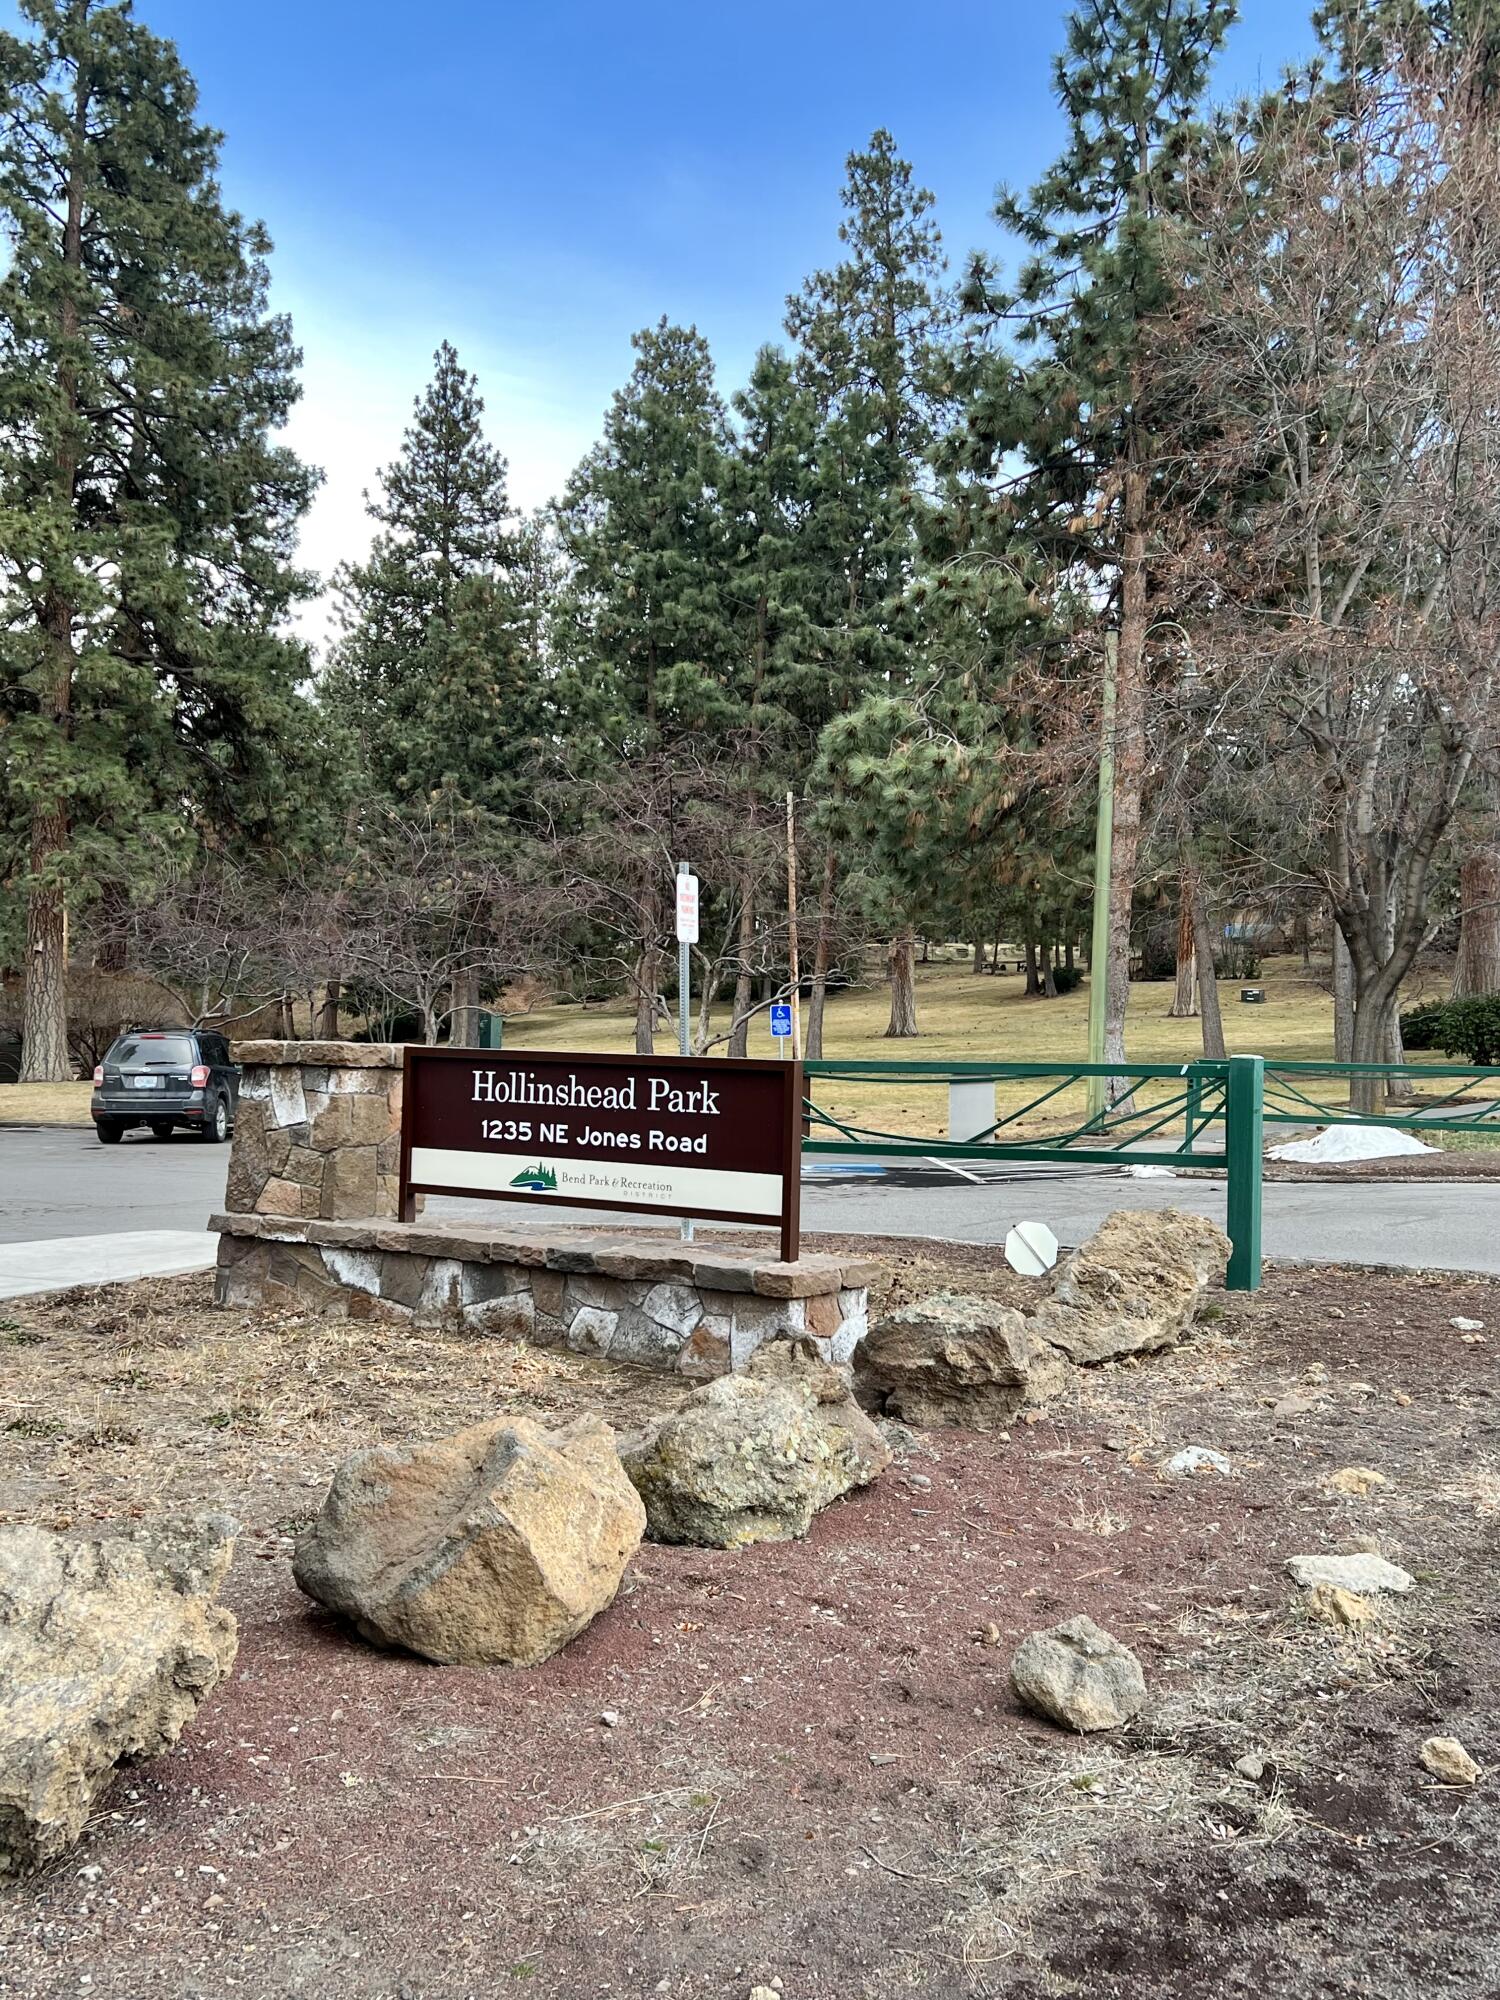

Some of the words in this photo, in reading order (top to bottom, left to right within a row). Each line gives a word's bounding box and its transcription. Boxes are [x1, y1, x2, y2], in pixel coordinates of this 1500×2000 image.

[471, 1070, 636, 1110] Hollinshead
[647, 1078, 721, 1115] Park
[481, 1119, 532, 1142] 1235
[539, 1123, 569, 1144] NE
[576, 1126, 641, 1149] Jones
[648, 1130, 707, 1153] Road
[562, 1172, 586, 1185] Bend
[589, 1175, 609, 1186] Park
[611, 1179, 620, 1188] &
[621, 1177, 672, 1192] Recreation
[623, 1190, 673, 1200] DISTRICT
